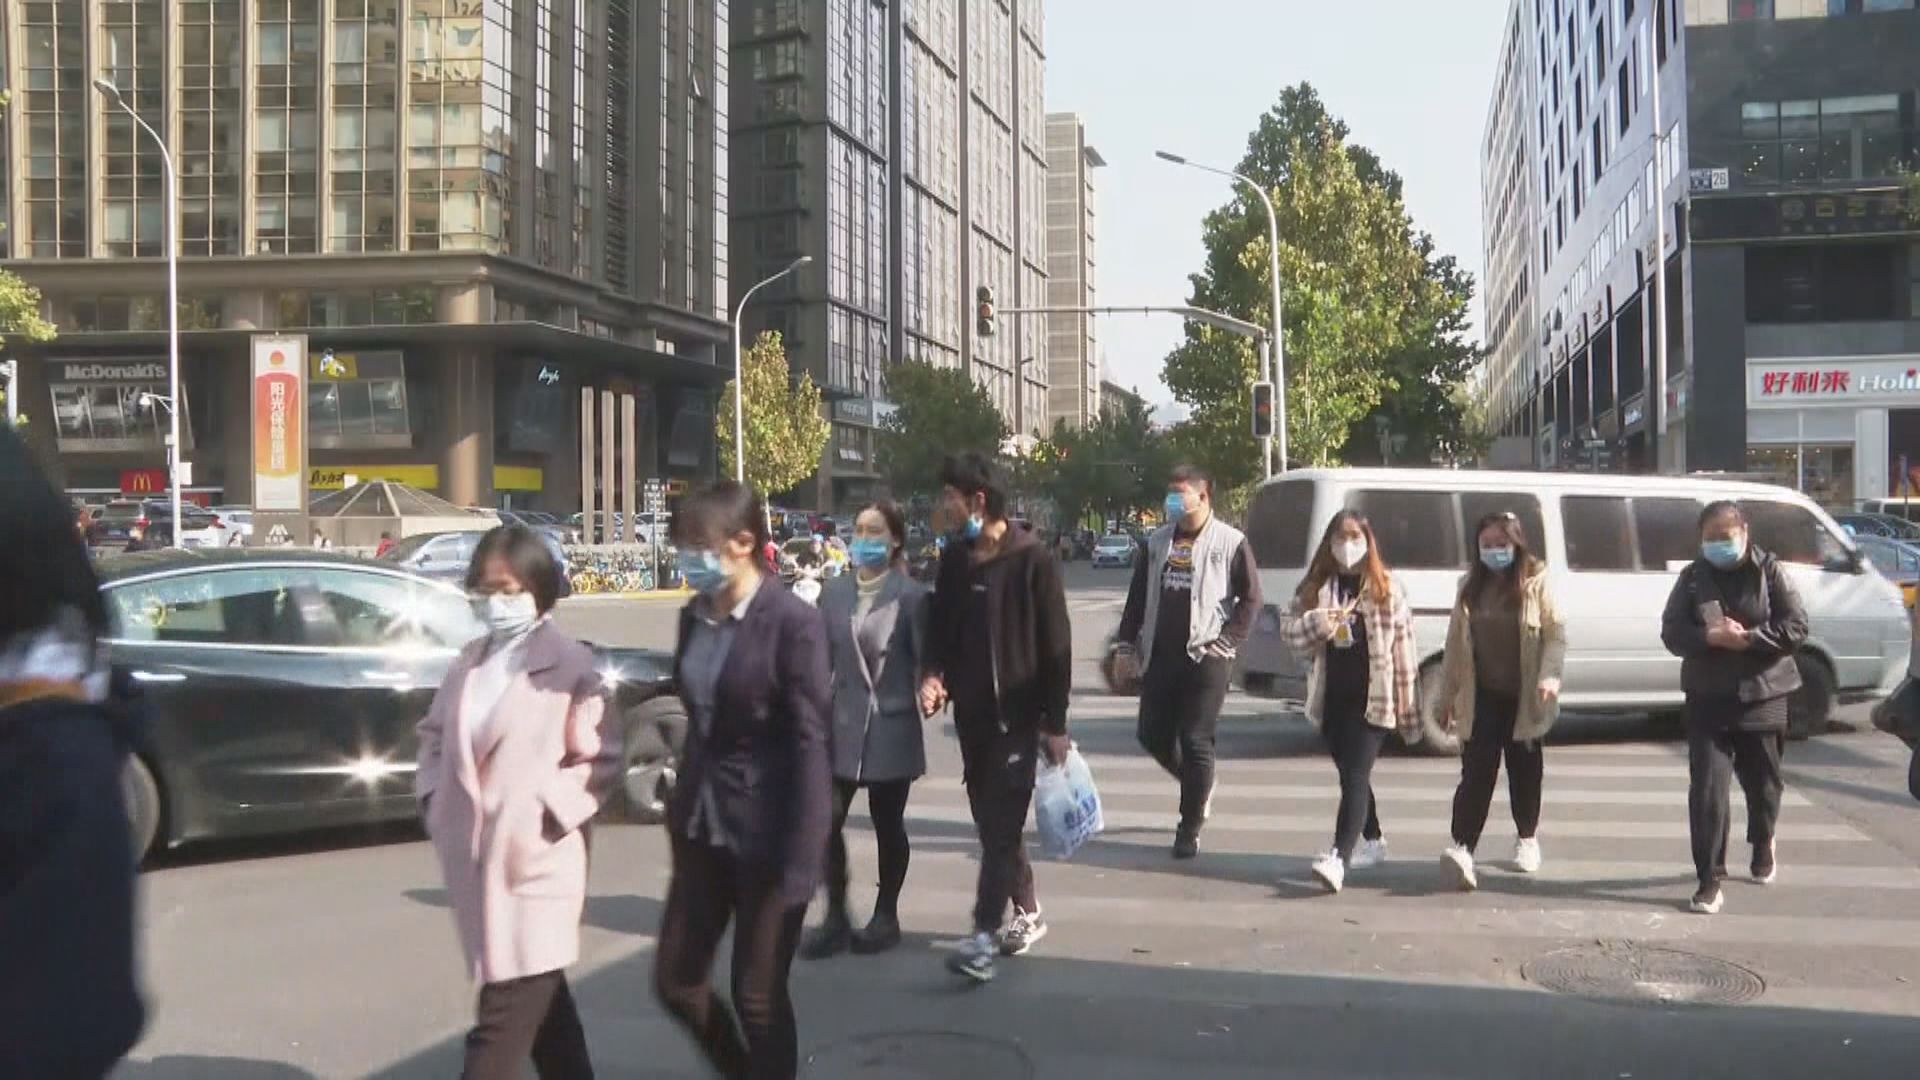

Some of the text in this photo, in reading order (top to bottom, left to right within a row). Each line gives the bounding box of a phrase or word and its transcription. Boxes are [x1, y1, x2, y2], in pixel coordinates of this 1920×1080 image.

[64, 364, 167, 379] McDonald's
[1762, 369, 1850, 395] 好利来
